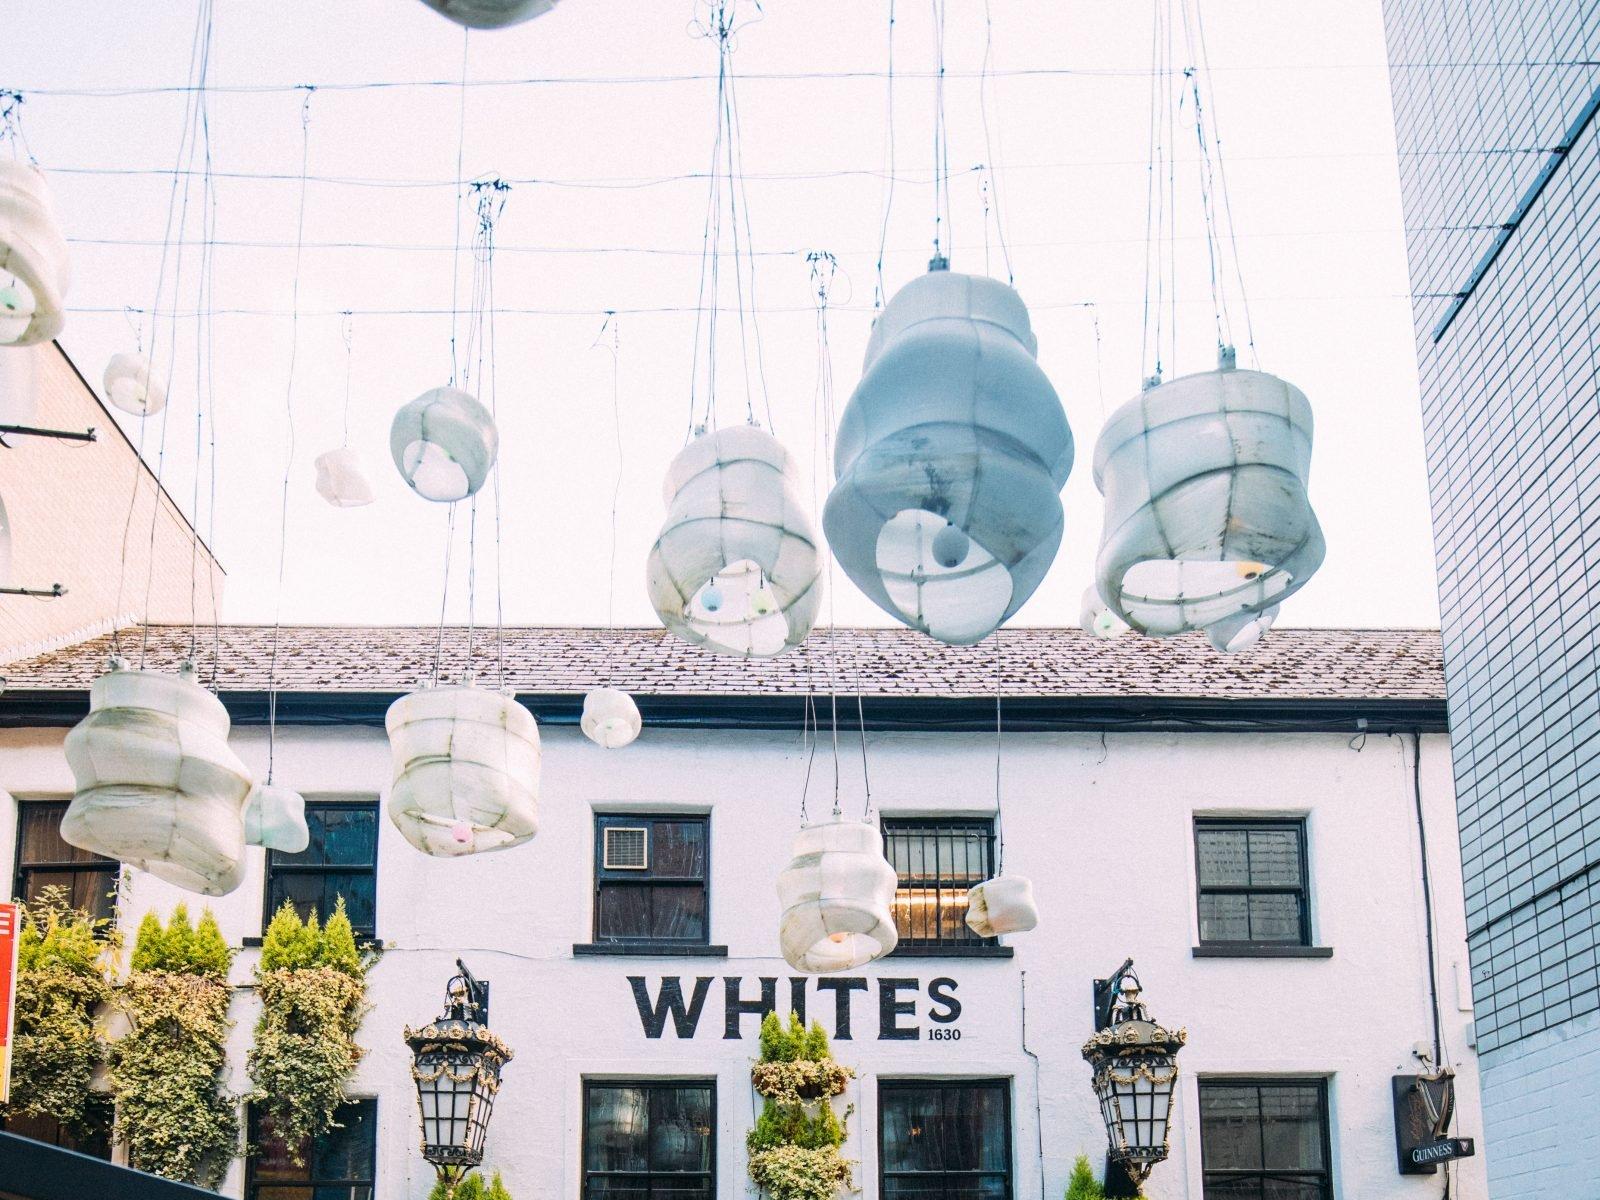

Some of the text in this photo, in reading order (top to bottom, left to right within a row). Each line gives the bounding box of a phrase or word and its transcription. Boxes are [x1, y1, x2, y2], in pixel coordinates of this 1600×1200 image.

[626, 976, 962, 1041] WHITES
[928, 1029, 962, 1041] 1630
[1412, 1143, 1452, 1162] GUINNESS
